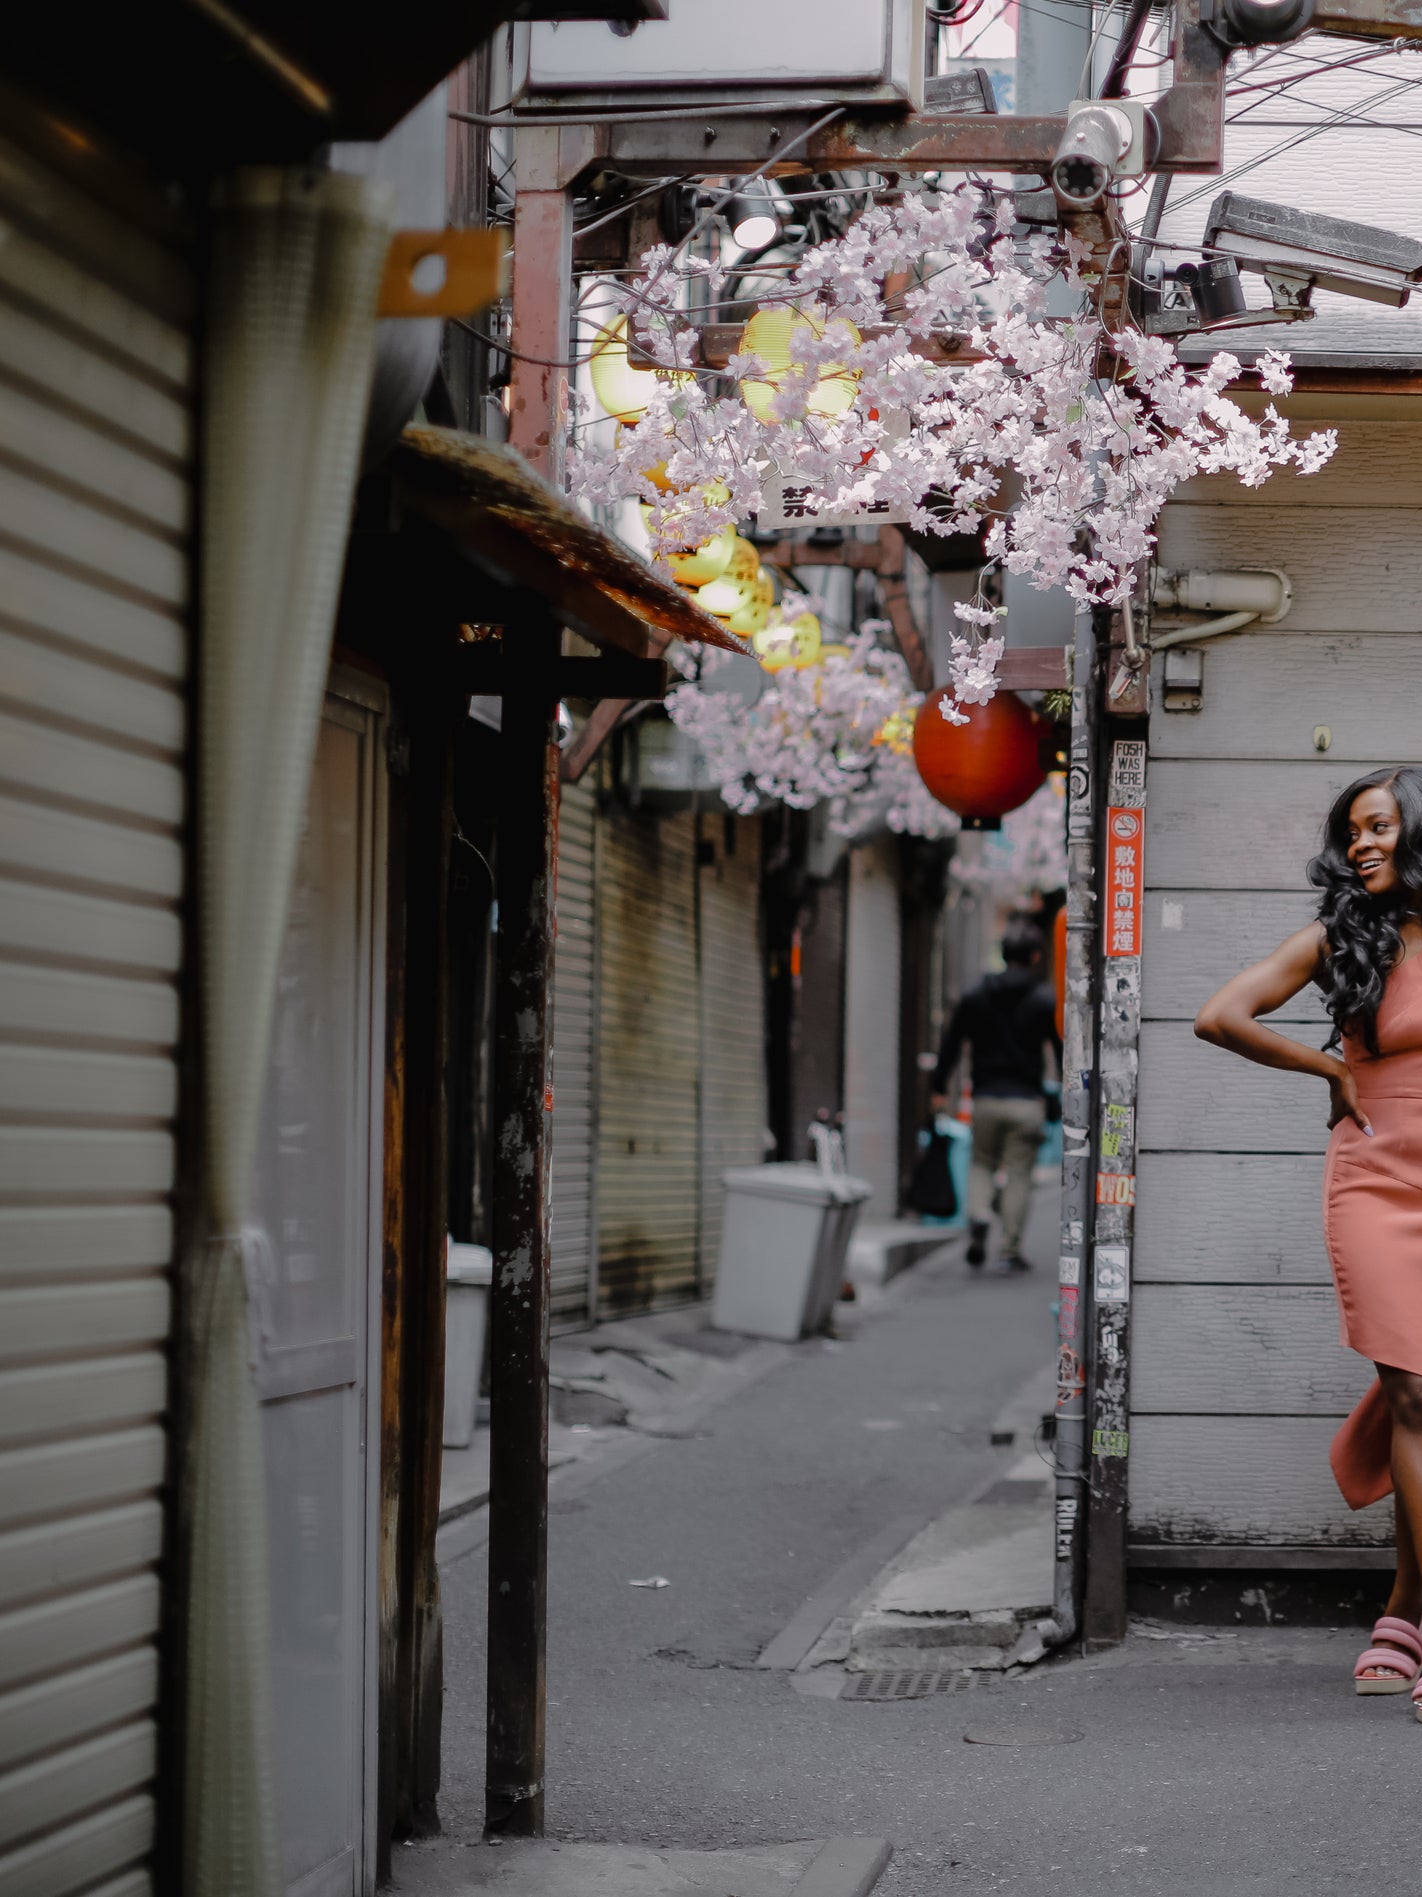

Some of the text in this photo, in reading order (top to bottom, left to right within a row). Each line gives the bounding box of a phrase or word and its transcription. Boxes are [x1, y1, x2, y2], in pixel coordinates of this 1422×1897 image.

[1115, 742, 1143, 757] FOSH
[1118, 757, 1140, 770] WAS
[1114, 771, 1142, 786] HERE
